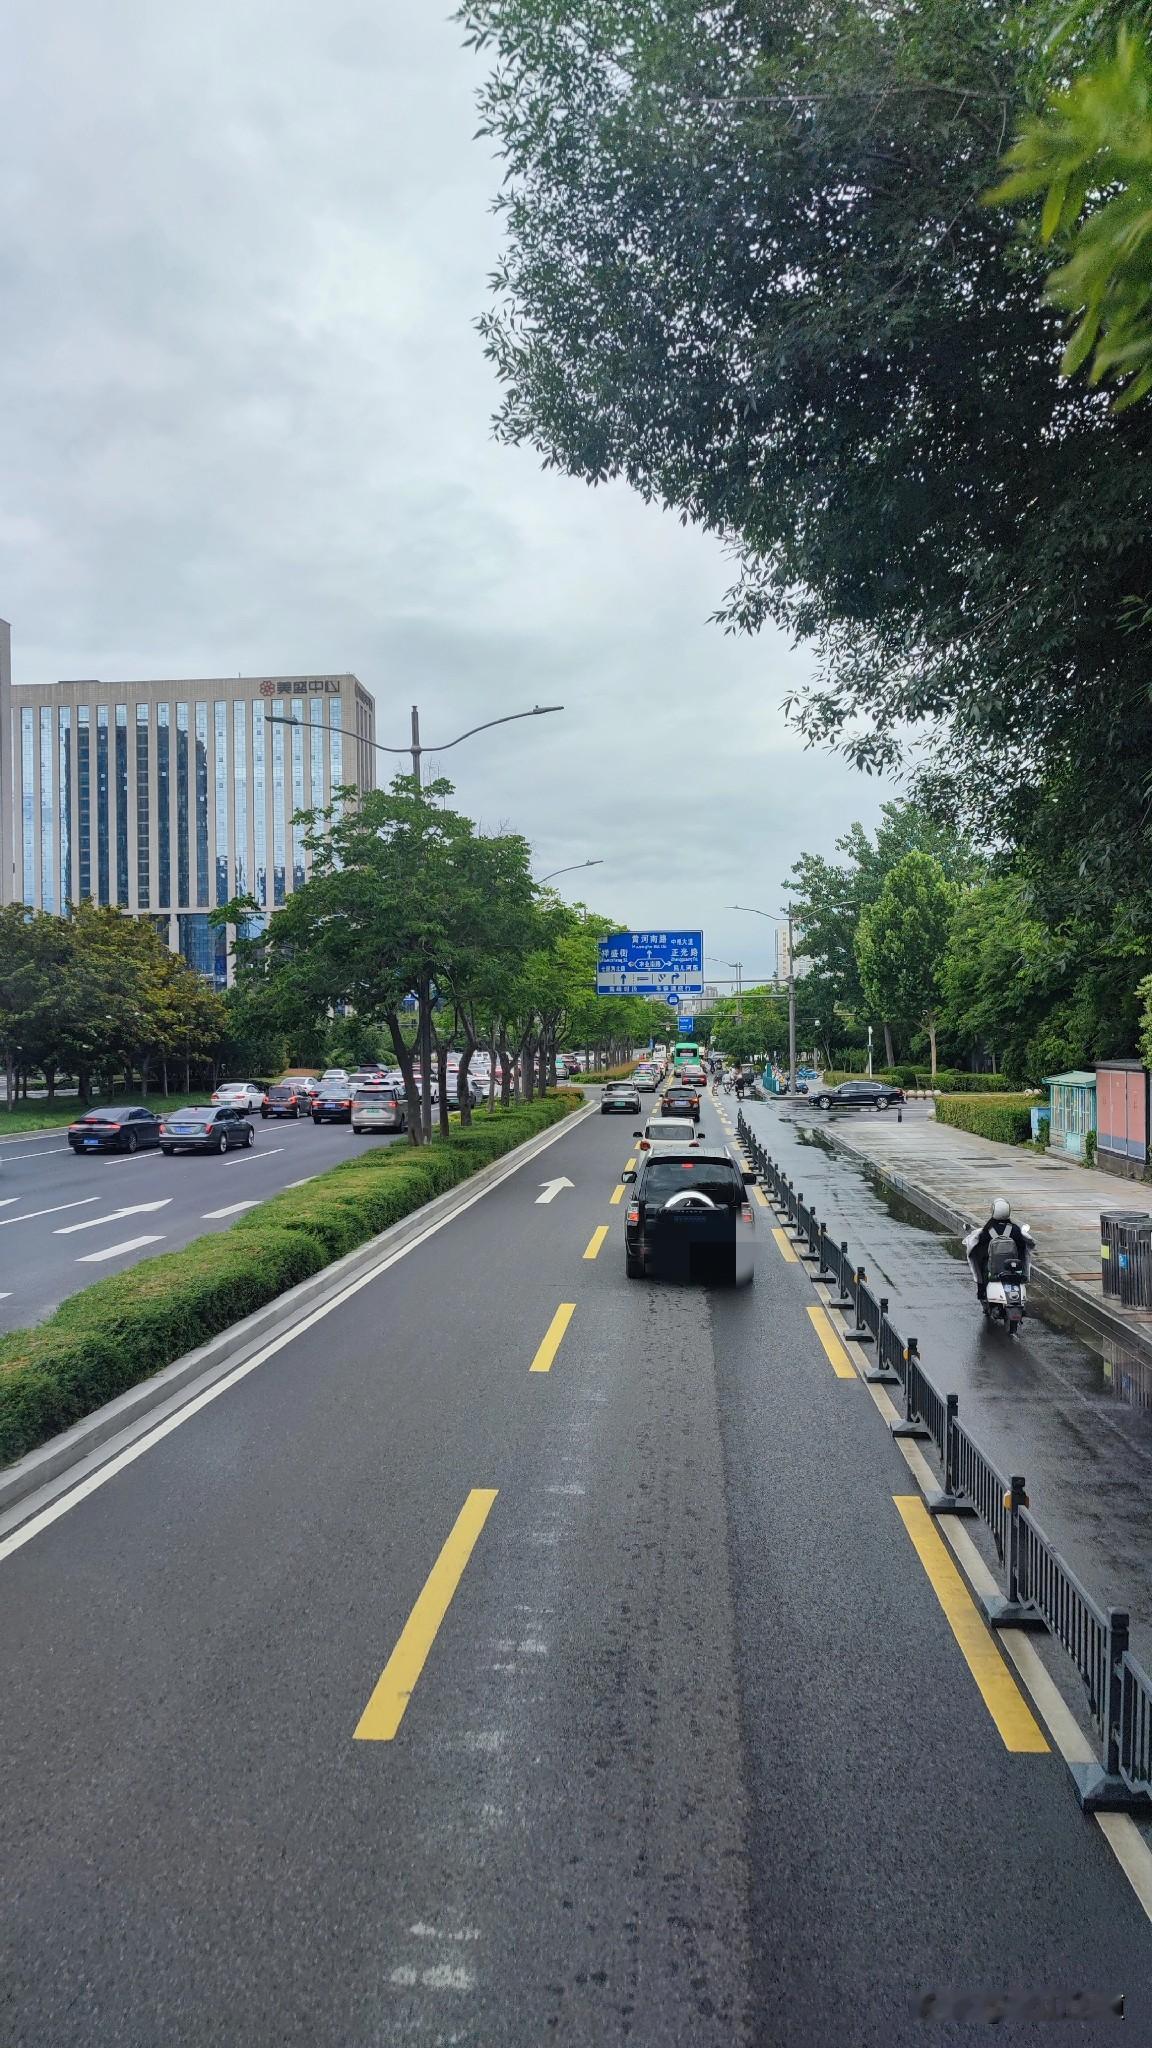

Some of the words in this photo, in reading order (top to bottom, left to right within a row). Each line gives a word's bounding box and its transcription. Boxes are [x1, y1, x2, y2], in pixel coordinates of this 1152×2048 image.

[277, 681, 340, 694] 美盛中心
[632, 934, 667, 944] 黄河南路
[670, 948, 698, 957] 正光路
